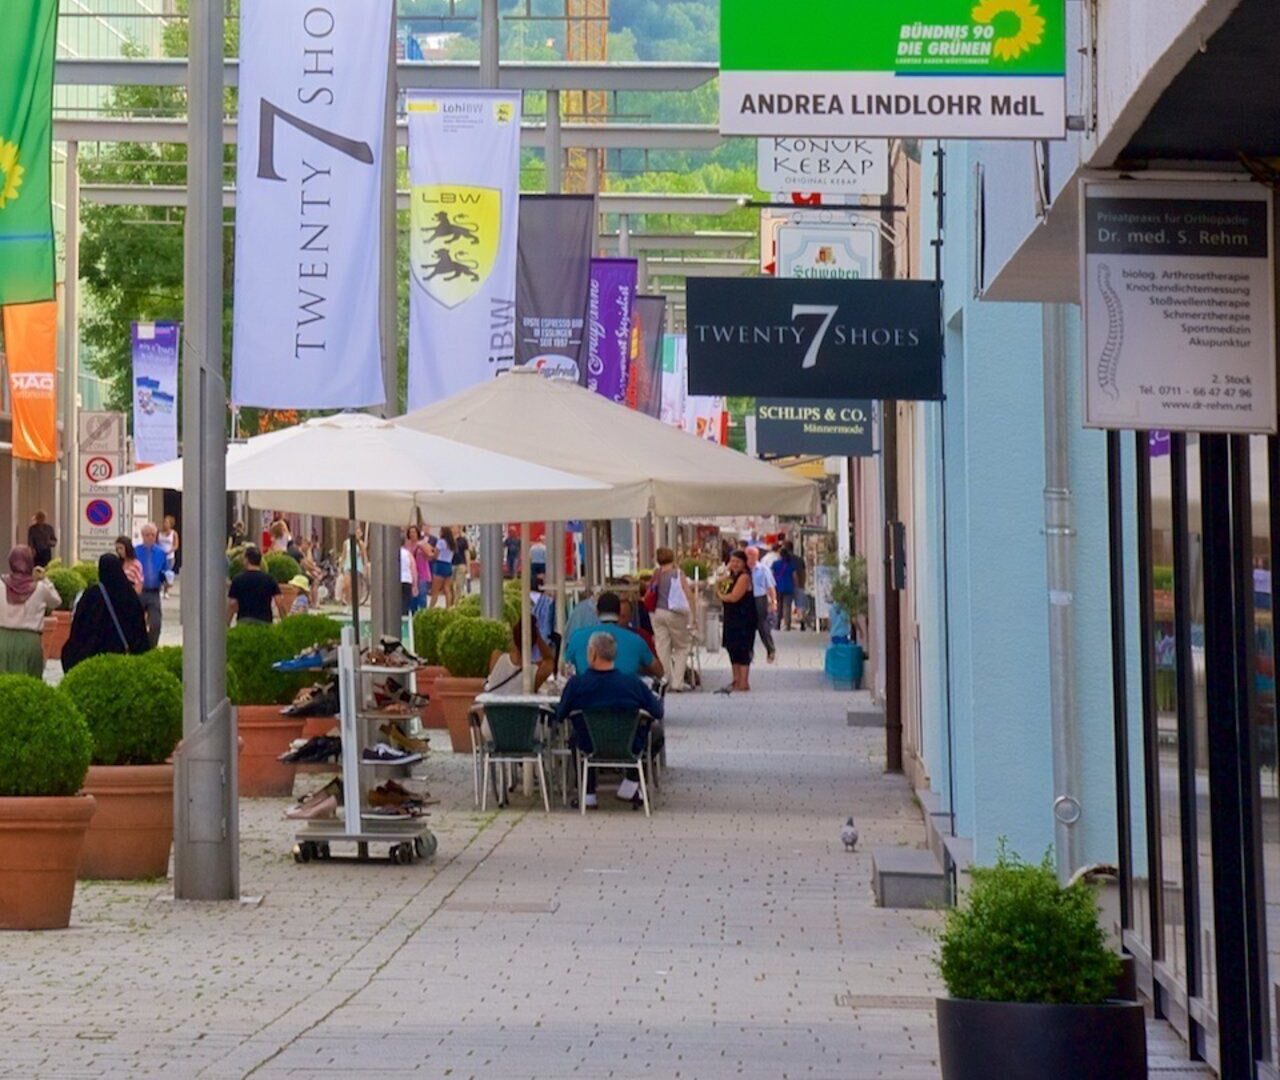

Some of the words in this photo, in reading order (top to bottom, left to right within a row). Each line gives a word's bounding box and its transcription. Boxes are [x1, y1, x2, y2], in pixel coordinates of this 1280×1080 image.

[900, 21, 969, 39] BÜNDNIS
[972, 25, 994, 39] 90
[897, 41, 923, 56] DIE
[927, 39, 992, 56] GRÜNEN
[740, 93, 845, 116] ANDREA
[851, 93, 982, 117] LINDLOHR
[991, 94, 1044, 118] MdL
[257, 96, 374, 183] 7
[772, 157, 874, 176] KEBAP
[422, 192, 481, 204] LBW
[1097, 228, 1121, 243] Dr.
[1128, 229, 1171, 245] med.
[1177, 230, 1192, 245] S.
[1199, 231, 1249, 247] Rehm
[295, 160, 332, 360] TWENTY
[1161, 270, 1251, 283] Arthrosetherapie
[1125, 283, 1251, 297] Knochendichtemessung
[1148, 296, 1251, 310] Stoßwellentherapie
[1162, 310, 1251, 323] Schmerztherapie
[694, 325, 806, 345] TWENTY
[791, 303, 839, 369] 7
[834, 324, 919, 346] SHOES
[1180, 323, 1252, 336] Sportmedizin
[1188, 337, 1252, 350] Akupunktur
[1211, 374, 1221, 385] 2.
[1224, 374, 1252, 386] Stock
[1139, 385, 1155, 396] Tel.
[1158, 386, 1182, 396] 0711
[759, 405, 821, 421] SCHLIPS
[823, 407, 837, 421] &
[840, 407, 868, 423] CO.
[803, 422, 864, 434] Männermode
[92, 463, 107, 477] 20
